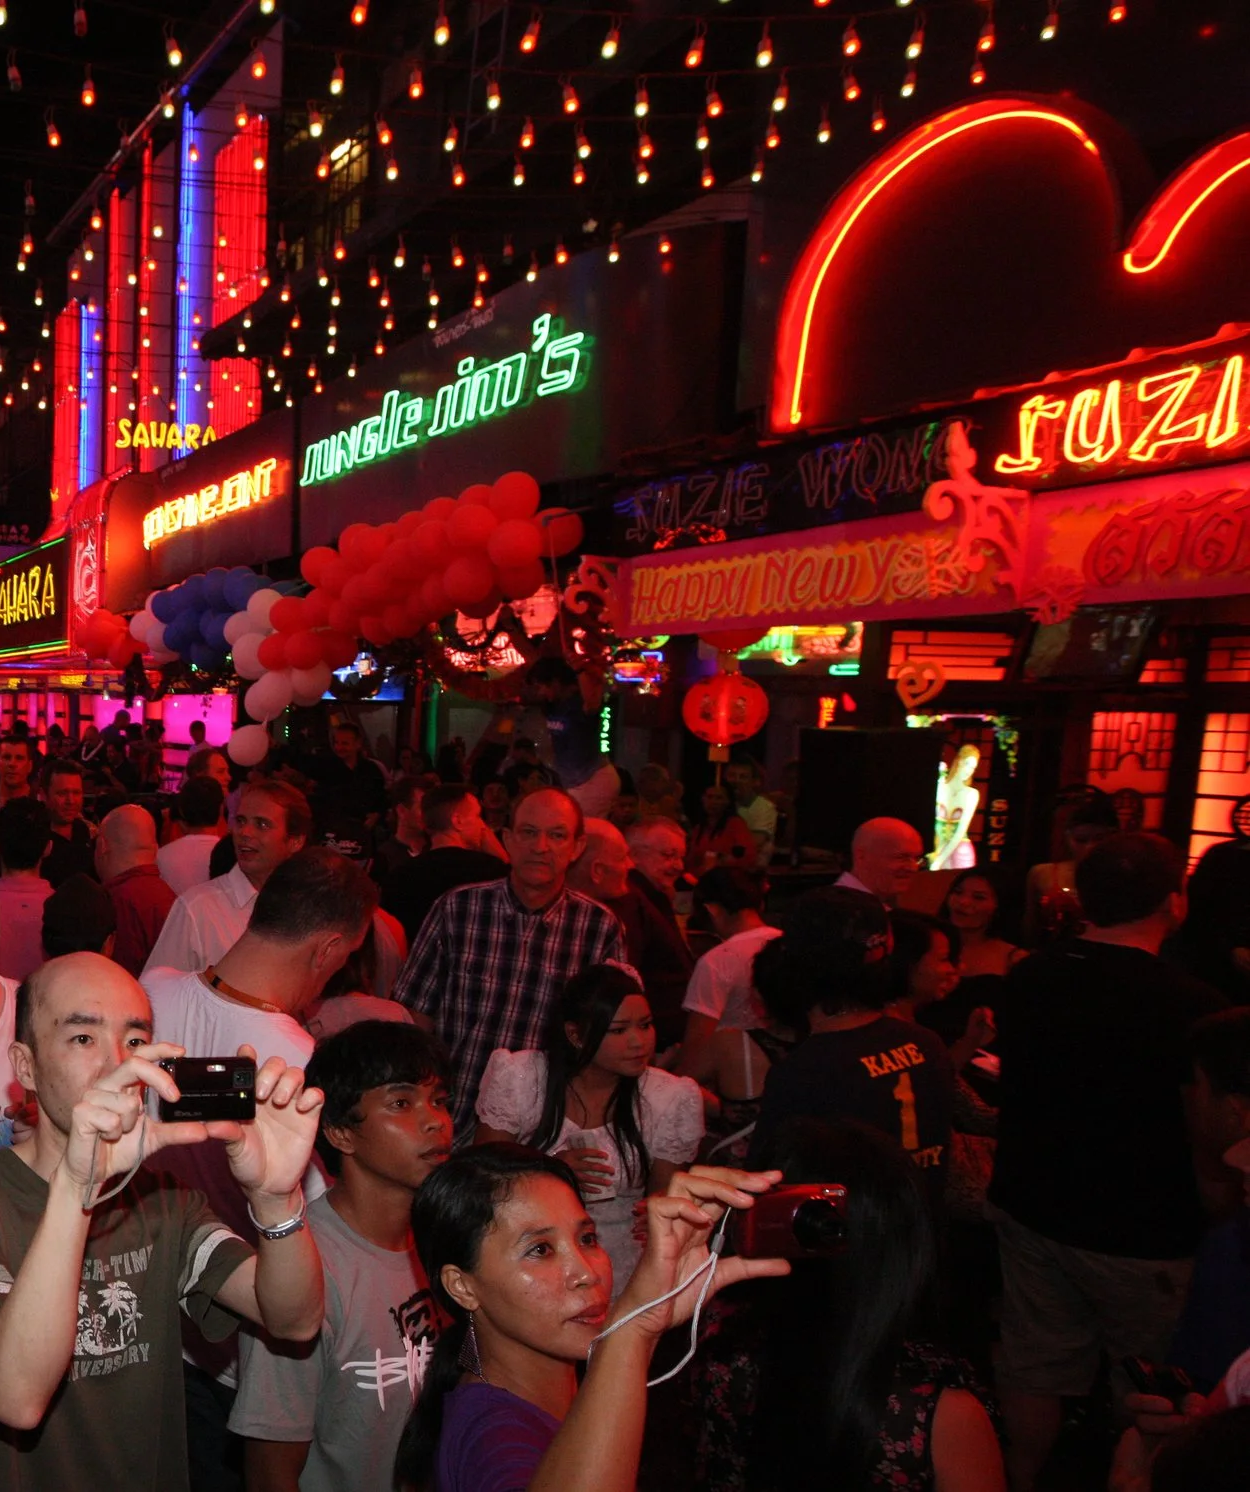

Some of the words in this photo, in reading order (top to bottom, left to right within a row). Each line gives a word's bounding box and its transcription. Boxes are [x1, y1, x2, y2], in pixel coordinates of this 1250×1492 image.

[114, 417, 217, 450] SAHARA
[993, 354, 1250, 475] SUZI
[633, 560, 754, 622] Happy
[761, 551, 861, 608] New
[860, 1042, 926, 1078] KANE
[893, 1072, 919, 1149] 1
[82, 1243, 154, 1281] ER-TIM
[70, 1342, 151, 1382] IVERSARY
